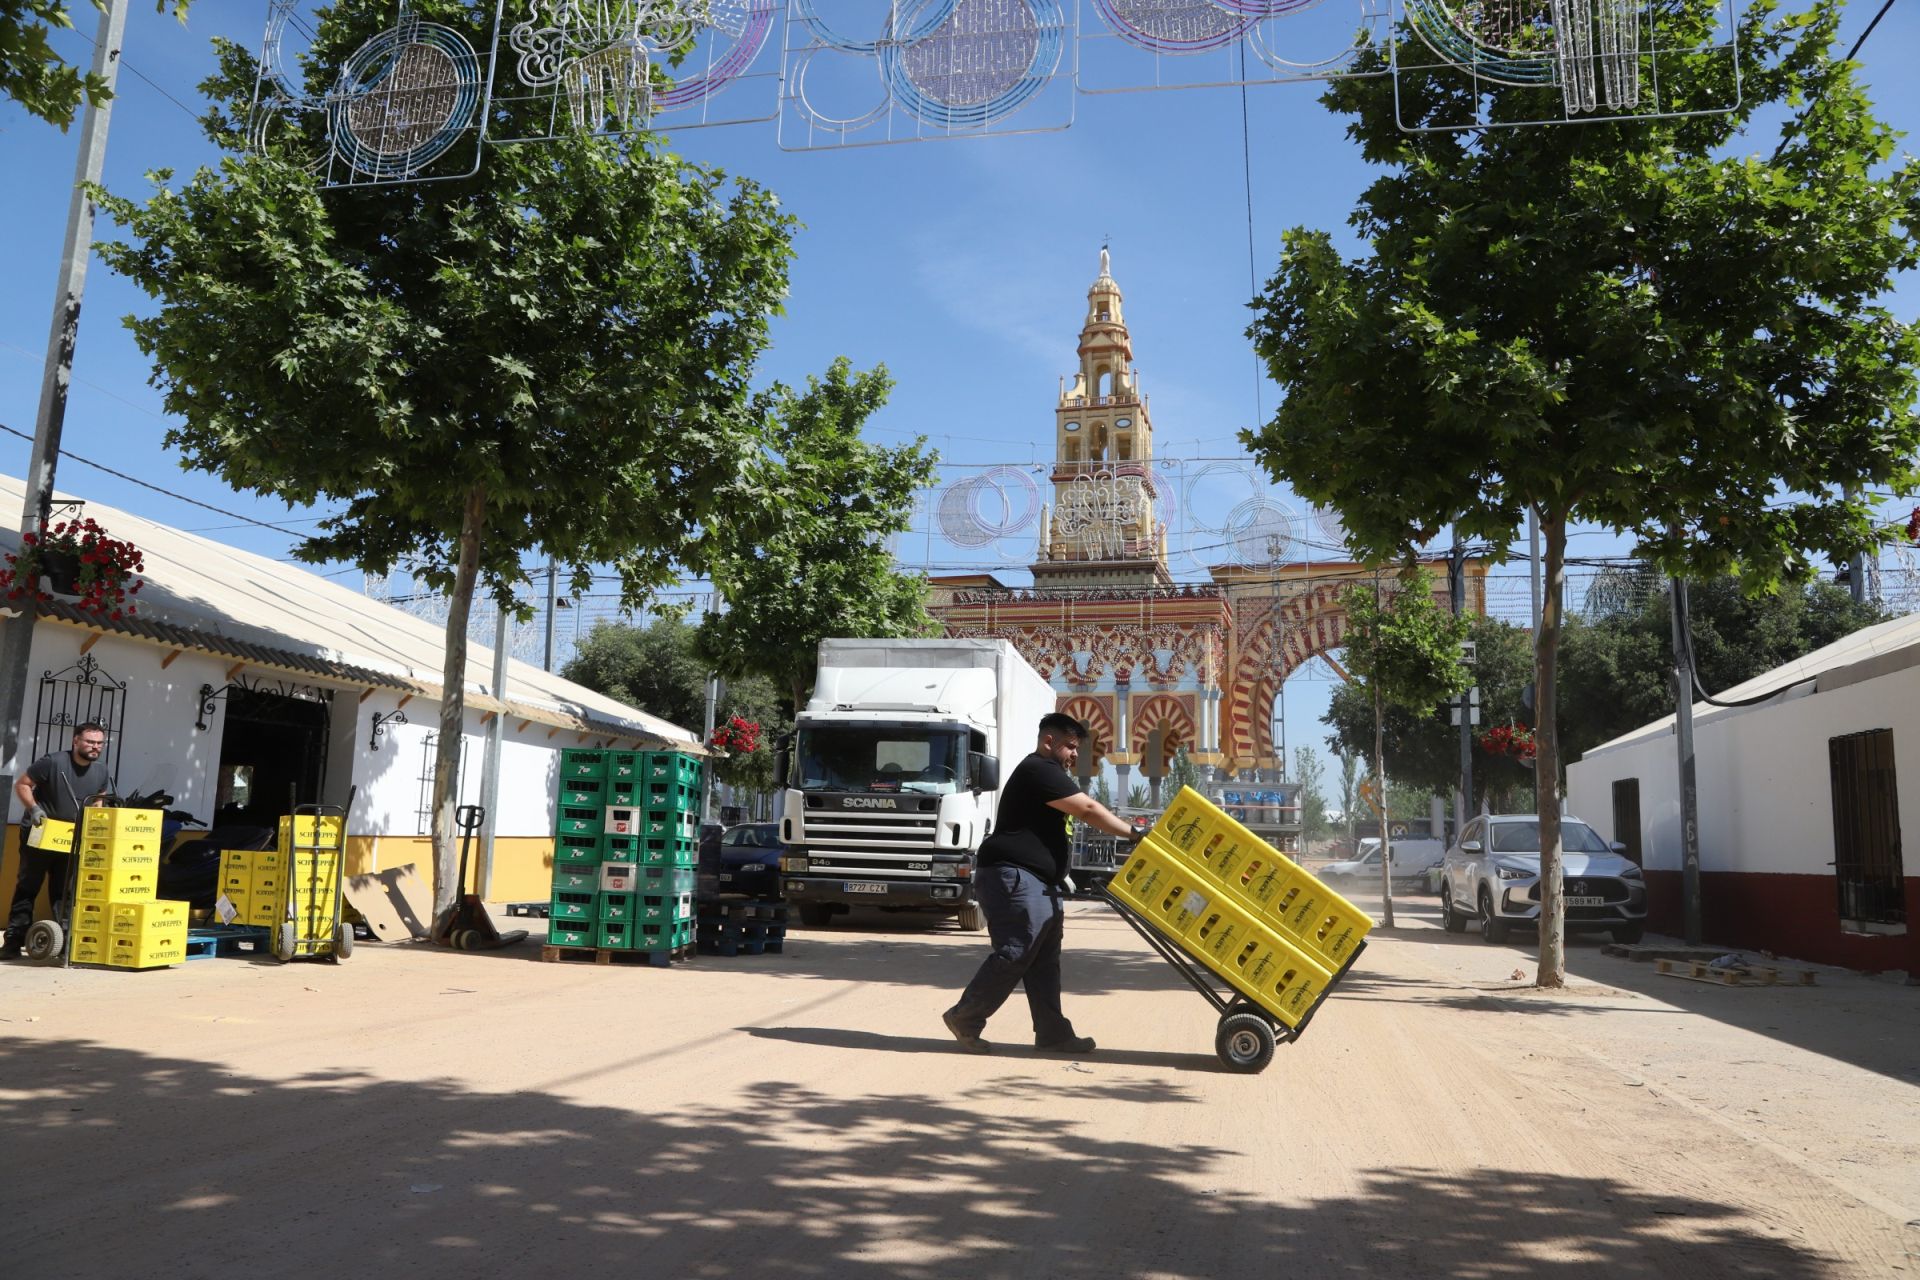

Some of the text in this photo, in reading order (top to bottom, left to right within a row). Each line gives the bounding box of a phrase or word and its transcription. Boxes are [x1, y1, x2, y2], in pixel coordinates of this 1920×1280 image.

[843, 798, 896, 808] SCANIA
[125, 826, 156, 834] SCHWEPPES
[52, 838, 71, 846] SCHW
[122, 856, 153, 864] SCHWEPPES
[908, 862, 928, 870] 220
[120, 886, 150, 894] SCHWEPPES
[870, 884, 886, 892] CZK
[152, 920, 182, 928] SCHWEPPES
